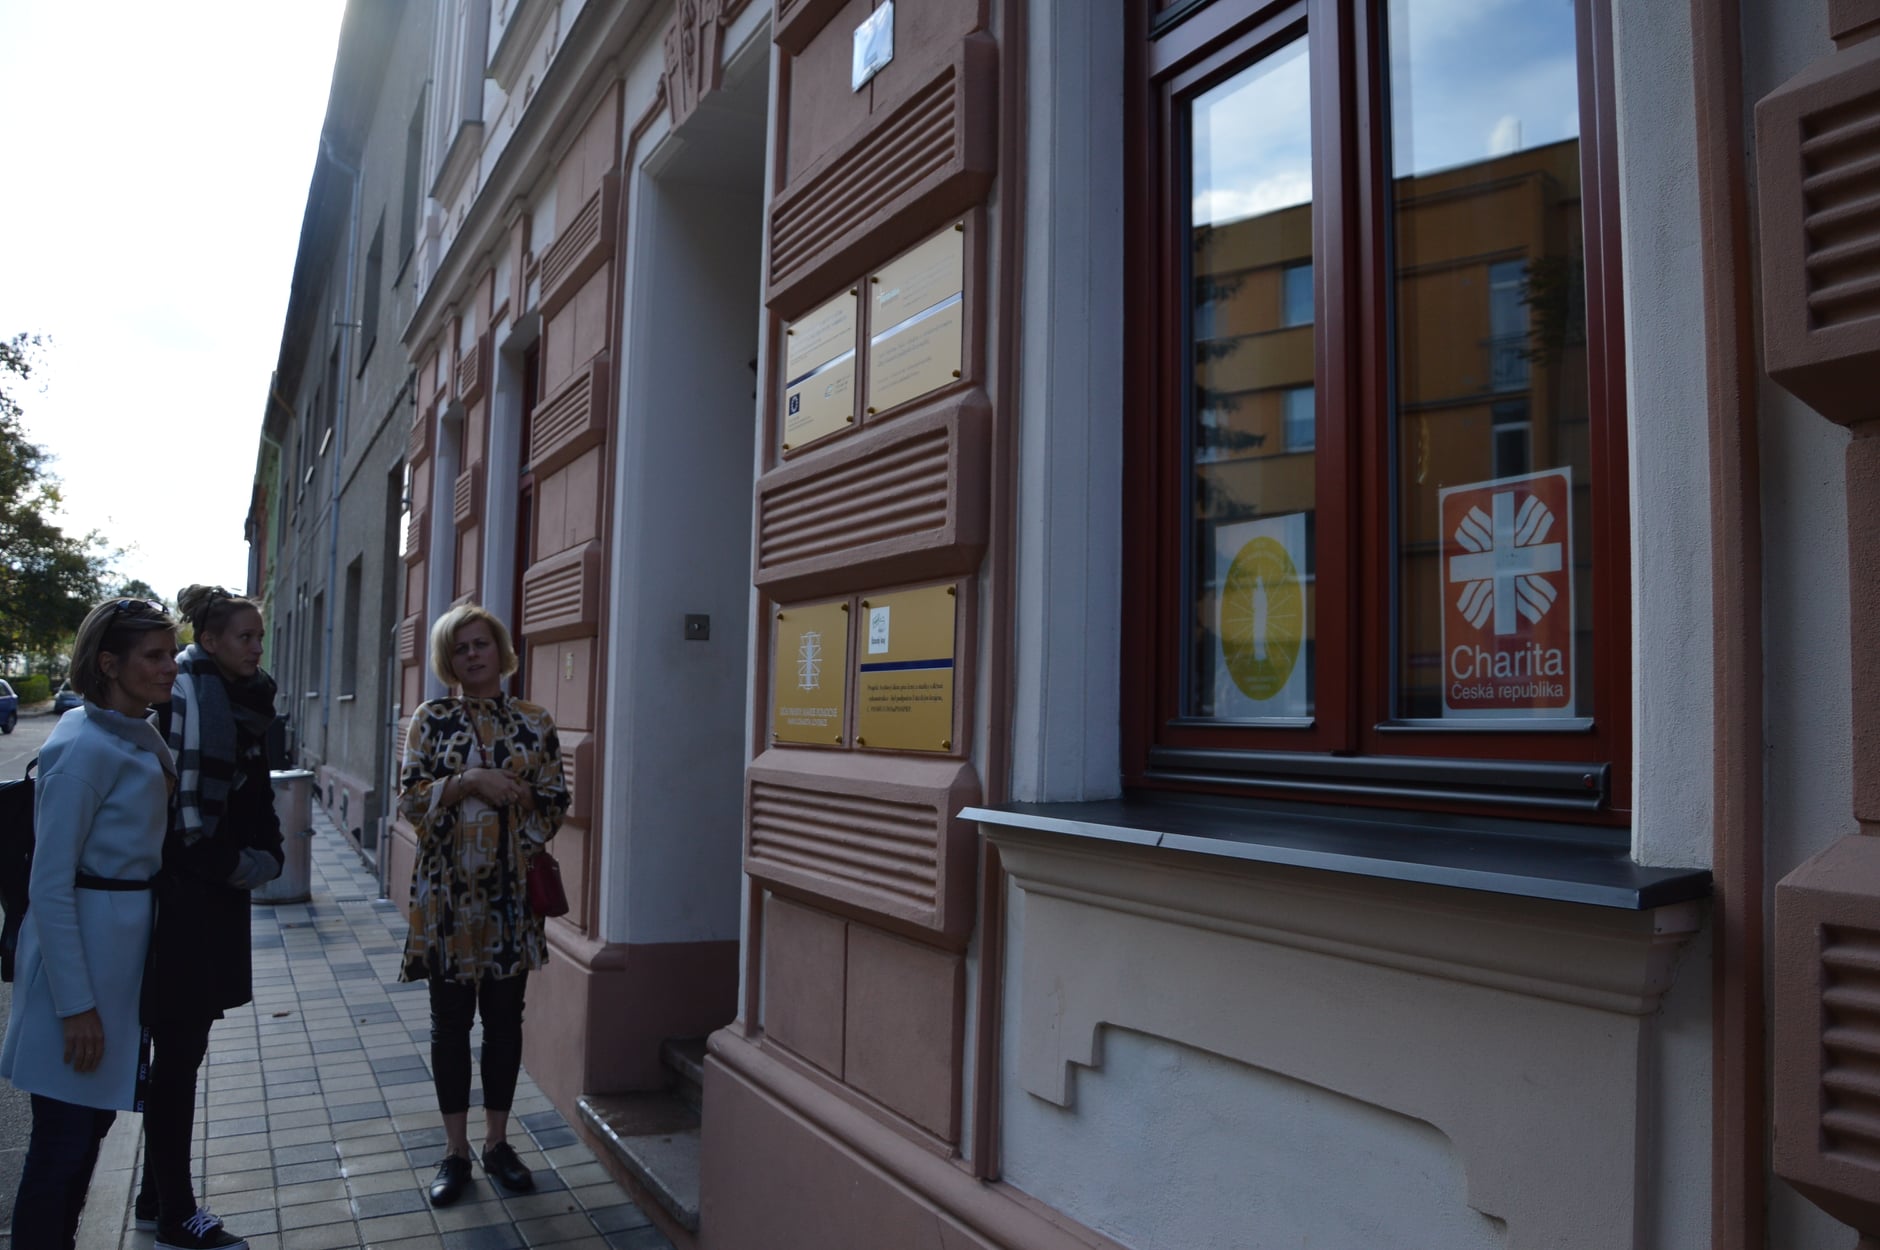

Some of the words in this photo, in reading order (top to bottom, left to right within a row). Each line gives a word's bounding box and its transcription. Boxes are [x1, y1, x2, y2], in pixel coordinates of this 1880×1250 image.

[1451, 641, 1564, 680] Charita
[1451, 681, 1495, 700] Česká
[1498, 681, 1564, 703] republika
